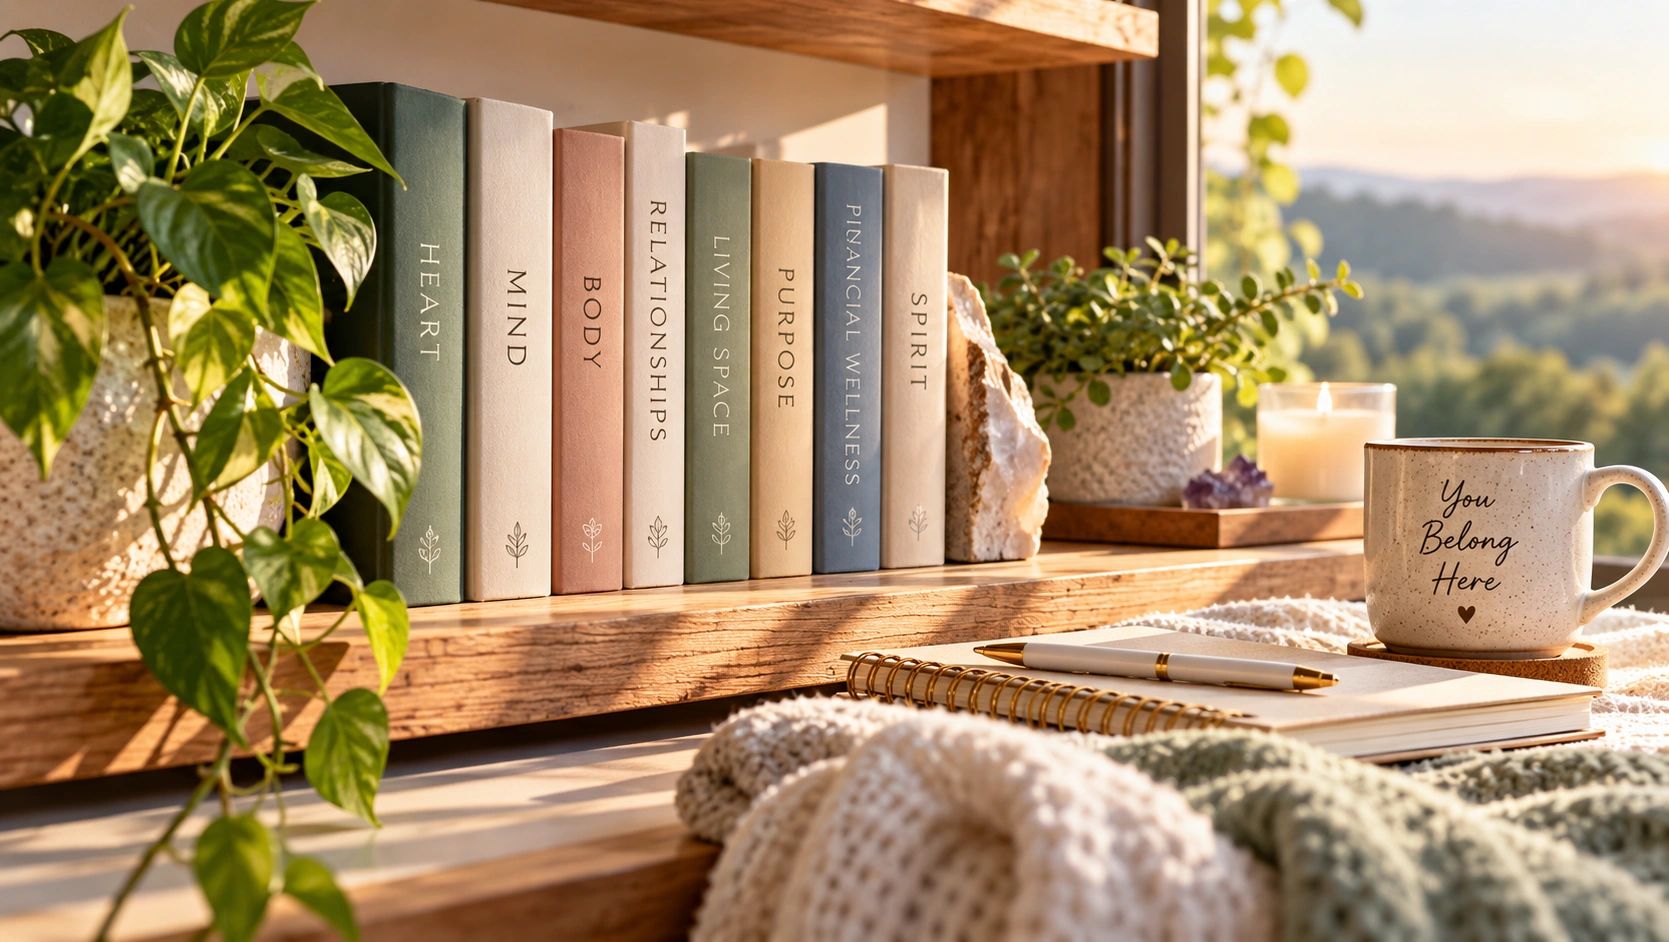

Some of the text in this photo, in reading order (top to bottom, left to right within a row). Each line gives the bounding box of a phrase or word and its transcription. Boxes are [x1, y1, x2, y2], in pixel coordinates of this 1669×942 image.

[419, 243, 440, 362] HEART
[507, 269, 528, 366] MIND
[583, 276, 602, 369] BODY
[650, 200, 667, 442] RELATIONSHIPS
[713, 235, 730, 437] LIVING SPACE
[777, 268, 796, 408] PURPOSE
[911, 292, 928, 390] SPIRIT
[844, 353, 861, 486] WELLNESS
[1419, 519, 1519, 567] Belong
[1441, 479, 1496, 519] You
[1432, 561, 1501, 596] Here
